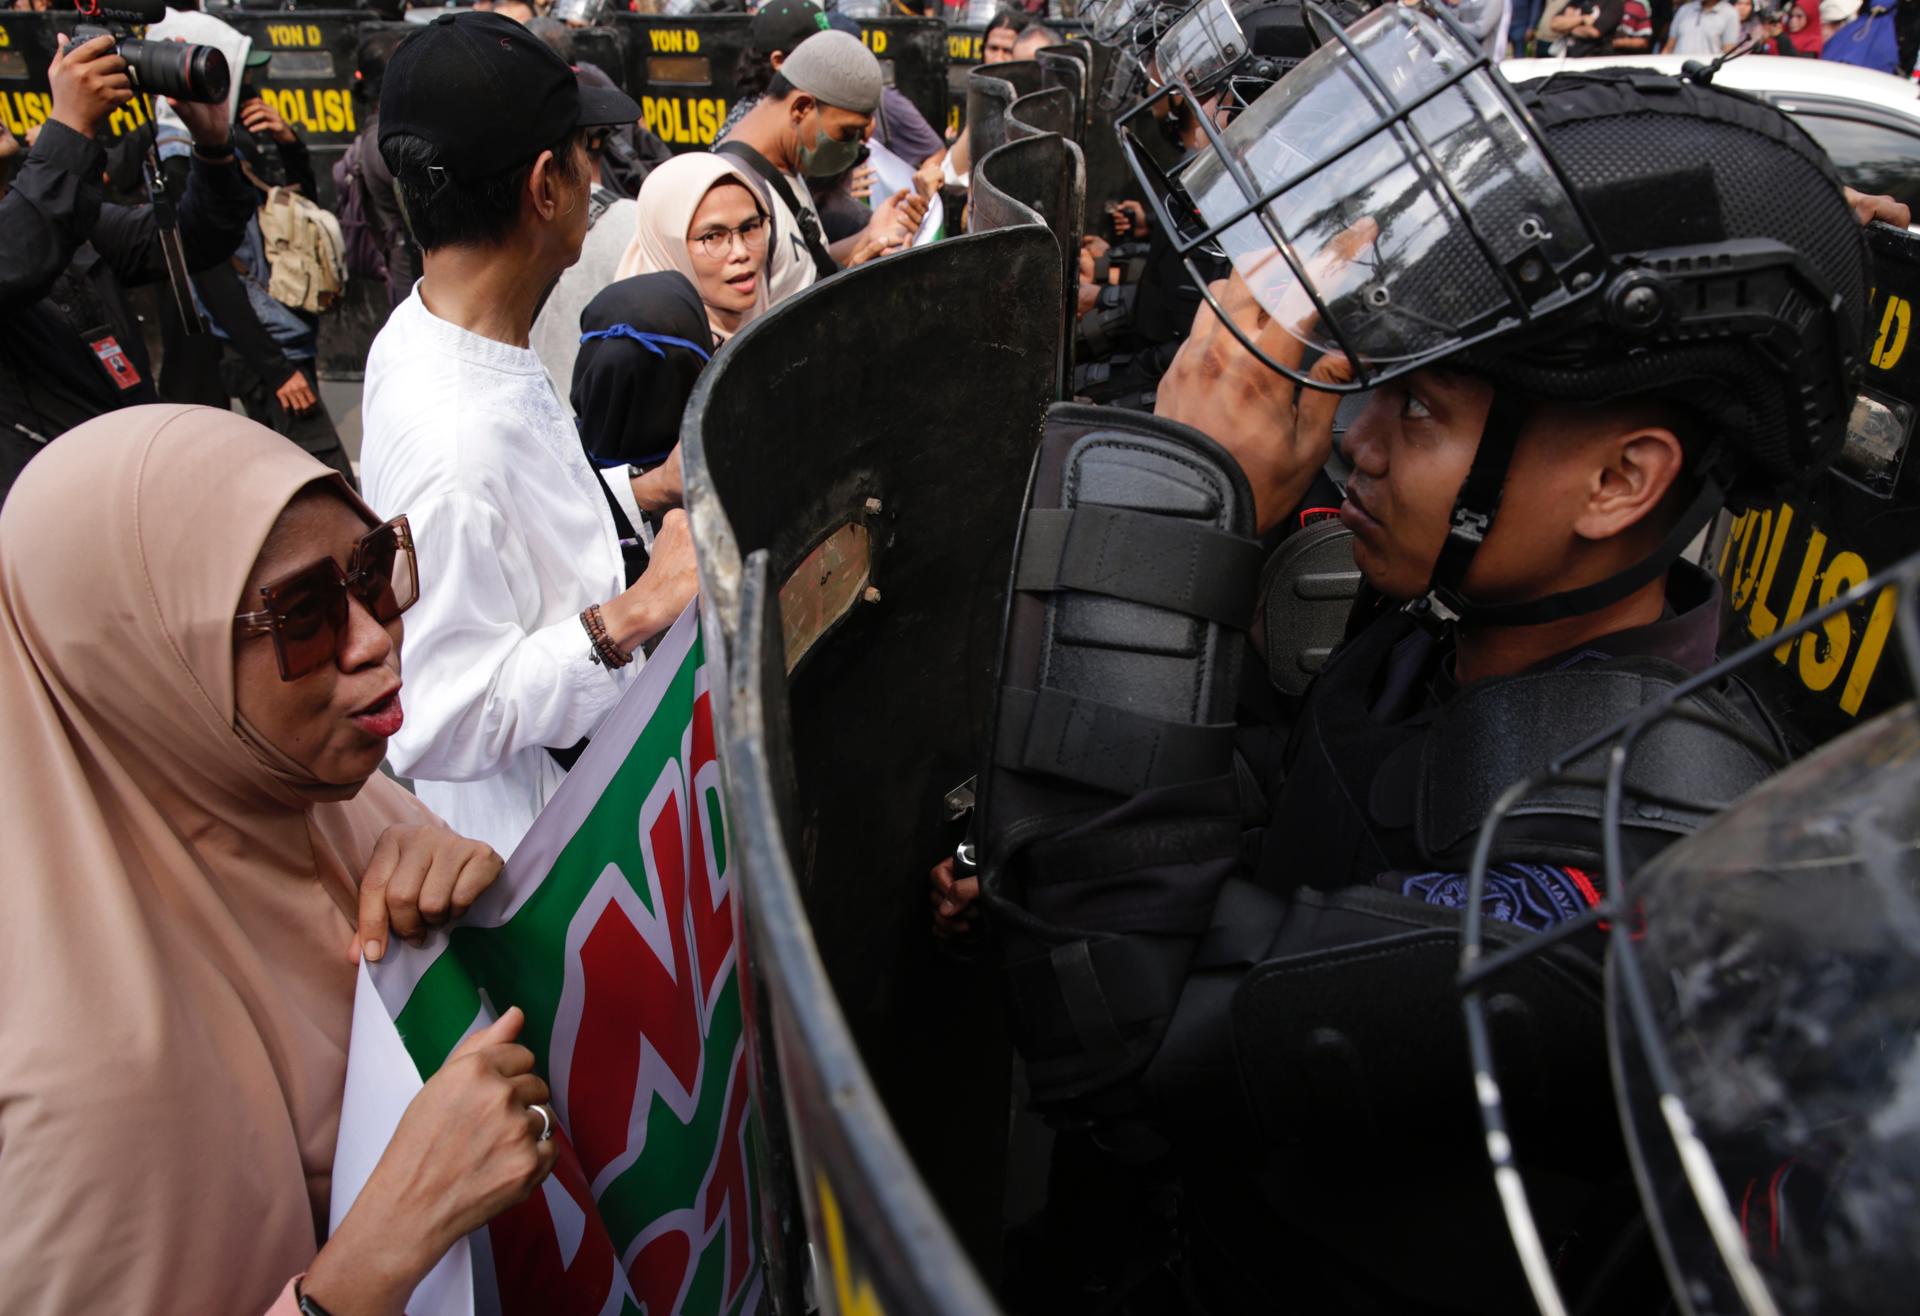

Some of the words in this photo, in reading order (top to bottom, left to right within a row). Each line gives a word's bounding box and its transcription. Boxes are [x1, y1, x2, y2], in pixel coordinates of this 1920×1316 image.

[266, 24, 304, 46] YON
[306, 24, 322, 46] D
[649, 29, 682, 52] YON
[685, 29, 700, 52] D
[641, 95, 728, 144] POLISI
[1869, 295, 1912, 371] D
[1717, 502, 1897, 718] POLISI
